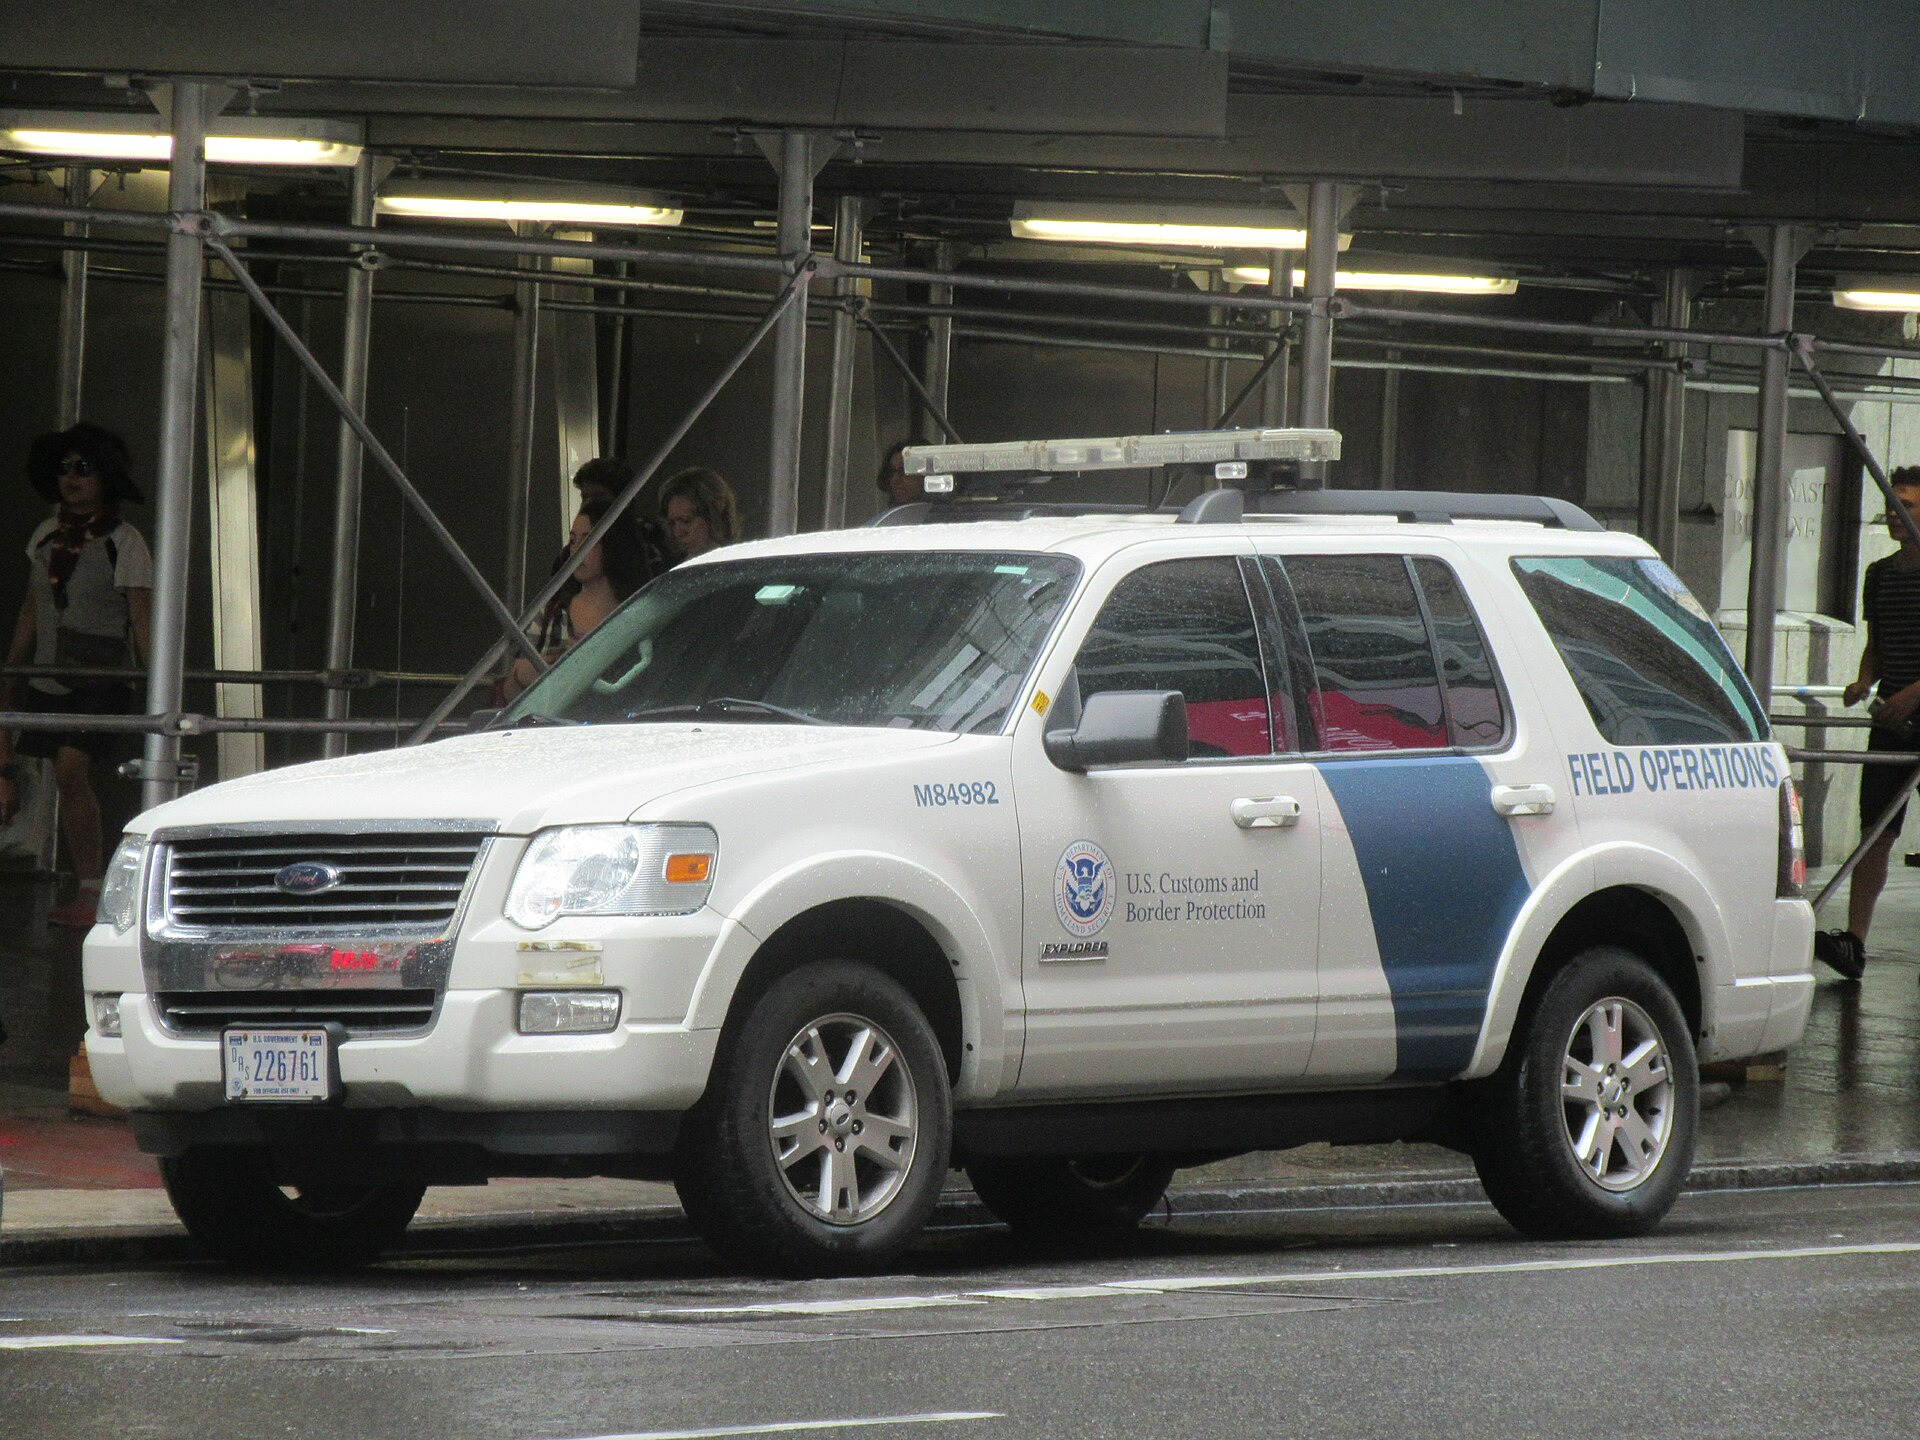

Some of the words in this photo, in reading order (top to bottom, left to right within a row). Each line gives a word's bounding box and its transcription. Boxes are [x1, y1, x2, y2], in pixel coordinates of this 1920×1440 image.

[1784, 477, 1829, 504] NAST
[1567, 751, 1634, 796] FIELD
[1639, 746, 1779, 792] OPERATIONS
[913, 780, 999, 807] M84982
[1065, 843, 1108, 868] DEPARTMENT
[284, 868, 319, 886] Ford
[1126, 873, 1156, 895] U.S.
[1159, 872, 1228, 894] Customs
[1231, 869, 1259, 892] and
[1056, 892, 1086, 934] HOMELAND
[1088, 894, 1114, 932] SECURITY
[1126, 900, 1181, 922] Border
[1186, 899, 1266, 920] Protection
[1042, 942, 1108, 954] EXPLORER
[263, 1035, 299, 1044] GOVERNMENT
[253, 1049, 319, 1082] 226761
